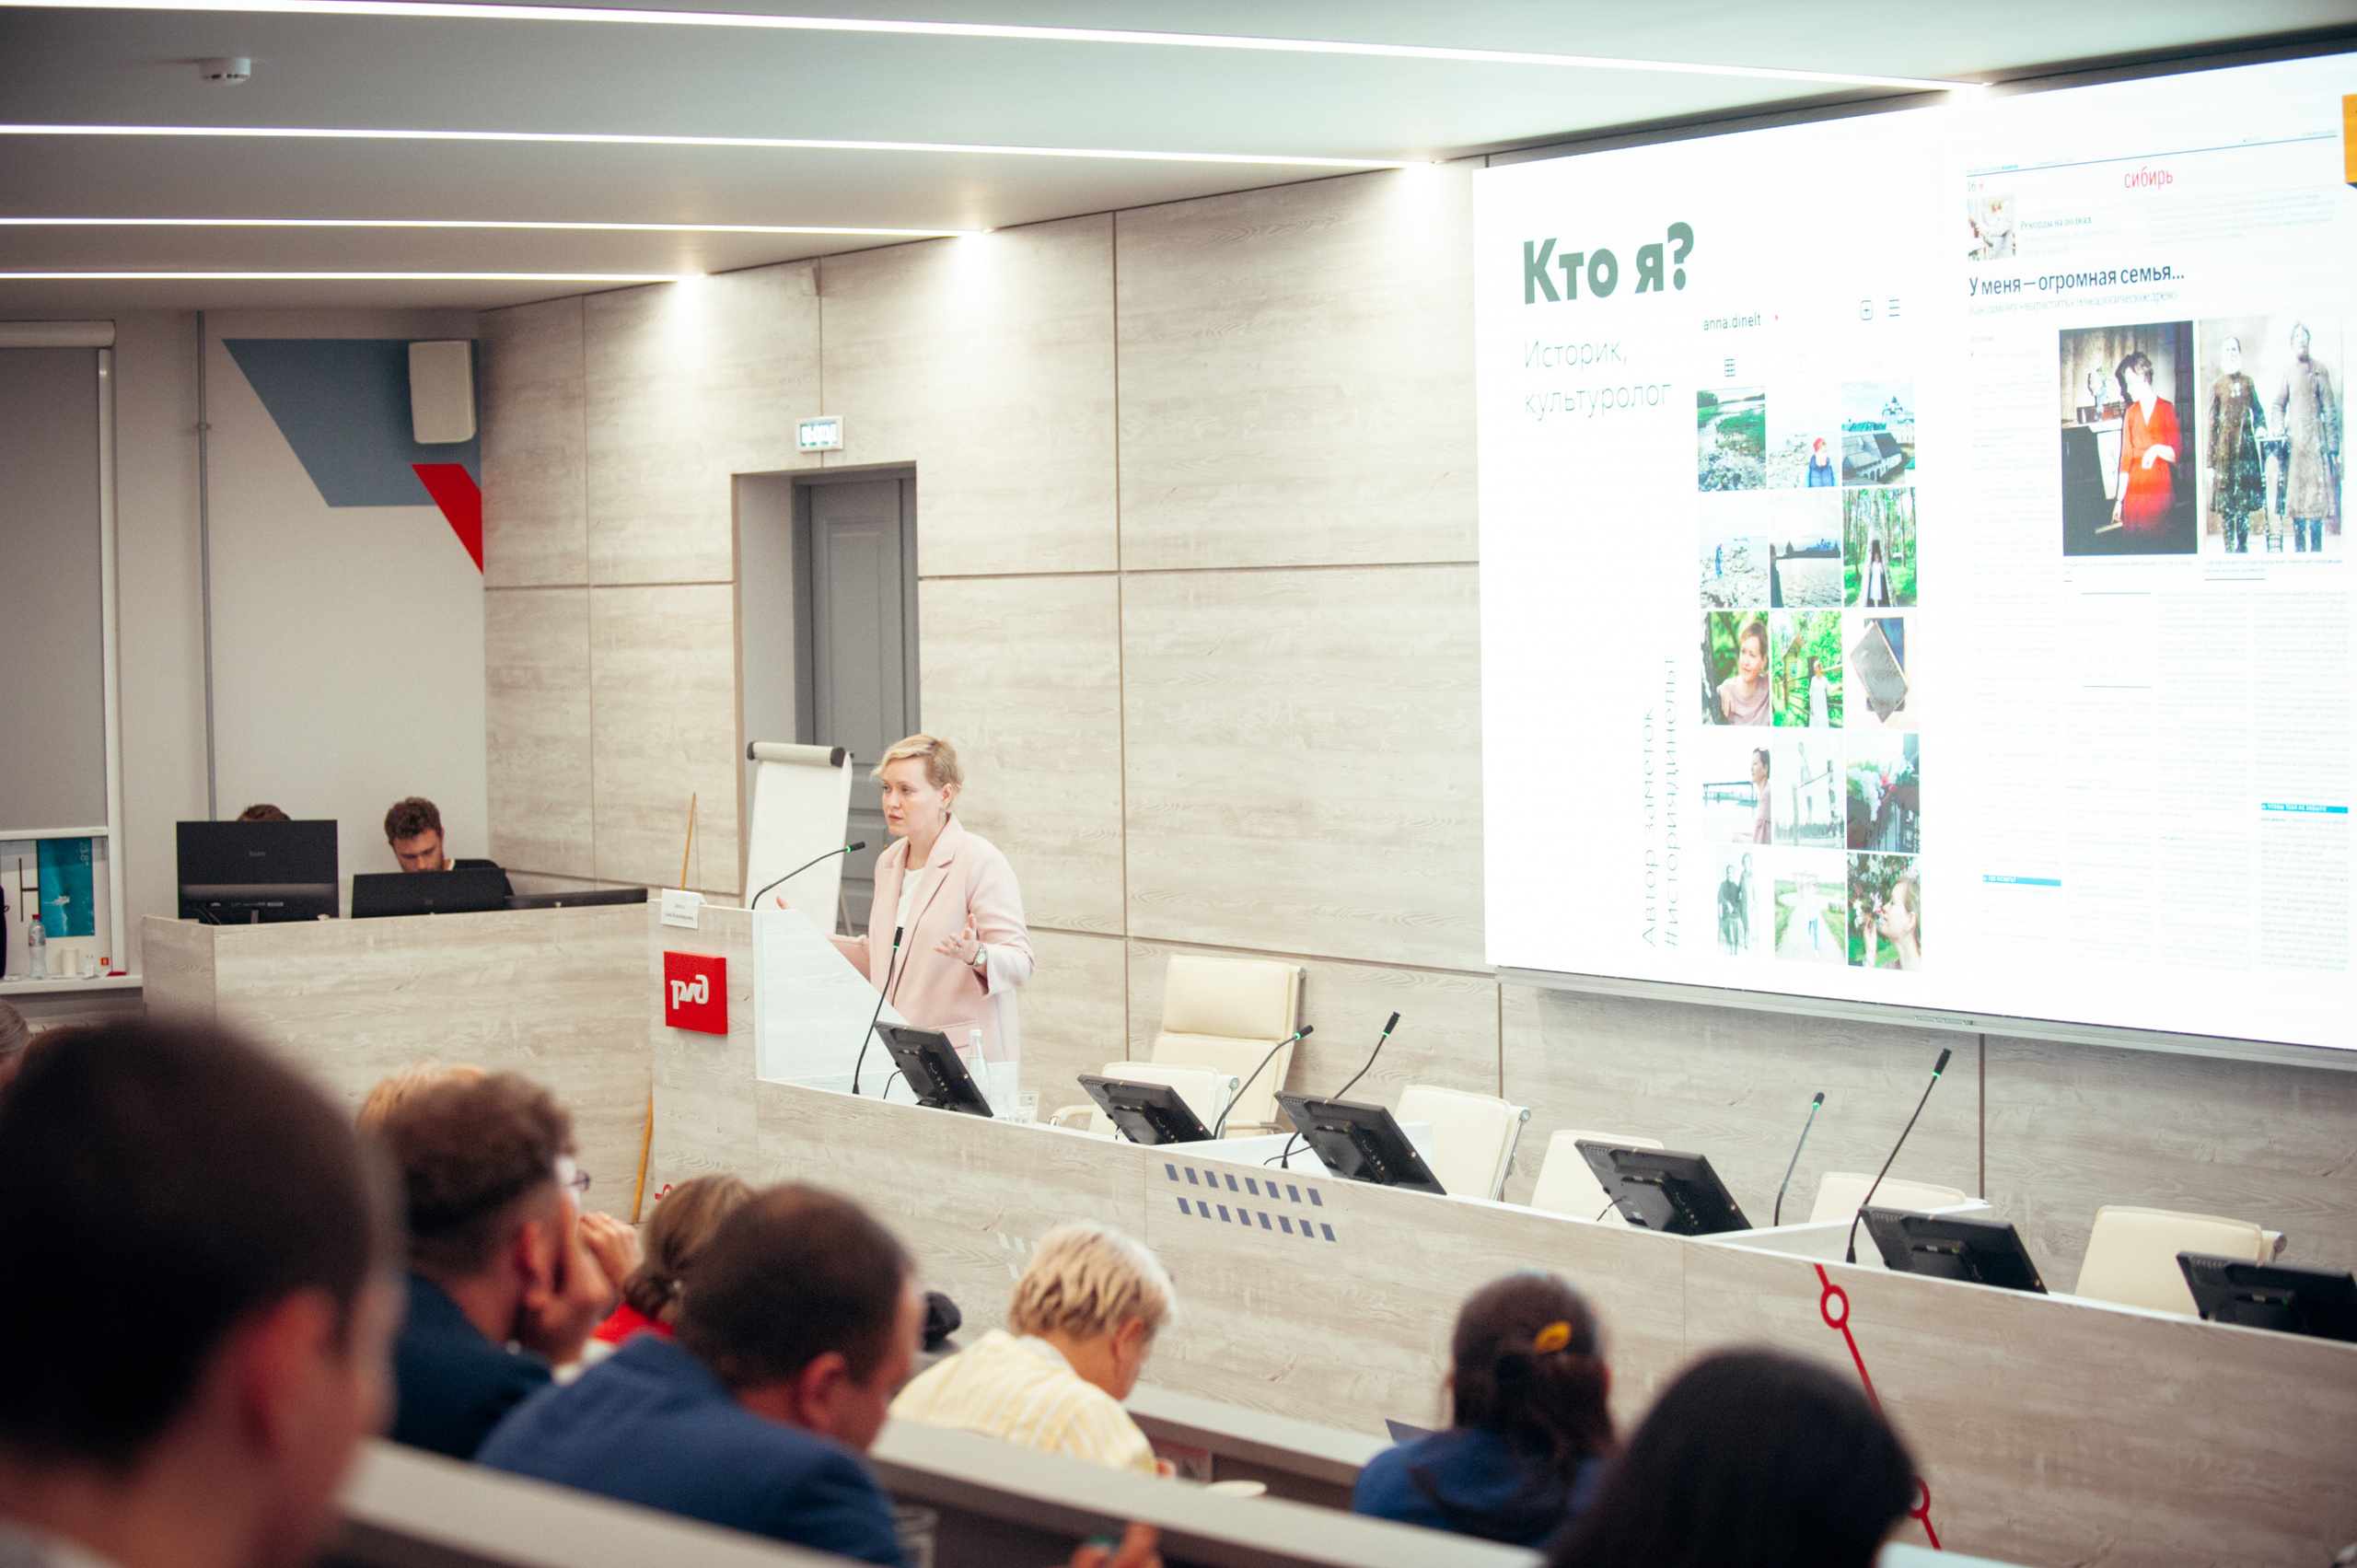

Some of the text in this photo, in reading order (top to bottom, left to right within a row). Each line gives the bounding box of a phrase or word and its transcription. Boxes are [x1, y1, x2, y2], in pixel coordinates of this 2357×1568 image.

[2124, 165, 2173, 191] сибирь
[2020, 216, 2092, 231] Рекорды на полках
[1523, 221, 1694, 305] Кто я?
[1969, 276, 1979, 296] У
[1981, 277, 2021, 296] меня
[2038, 272, 2117, 294] огромная
[2120, 265, 2185, 285] семья...
[1969, 304, 1984, 315] Как
[1985, 303, 2018, 315] самому
[2076, 294, 2149, 308] генеалогическое
[2151, 291, 2177, 305] древо
[1703, 311, 1761, 331] anna.dinelt
[1524, 338, 1628, 372] Историк,
[1524, 383, 1672, 421] культуролог
[1665, 655, 1681, 949] #историядинельт
[1642, 706, 1659, 947] Автор заметок
